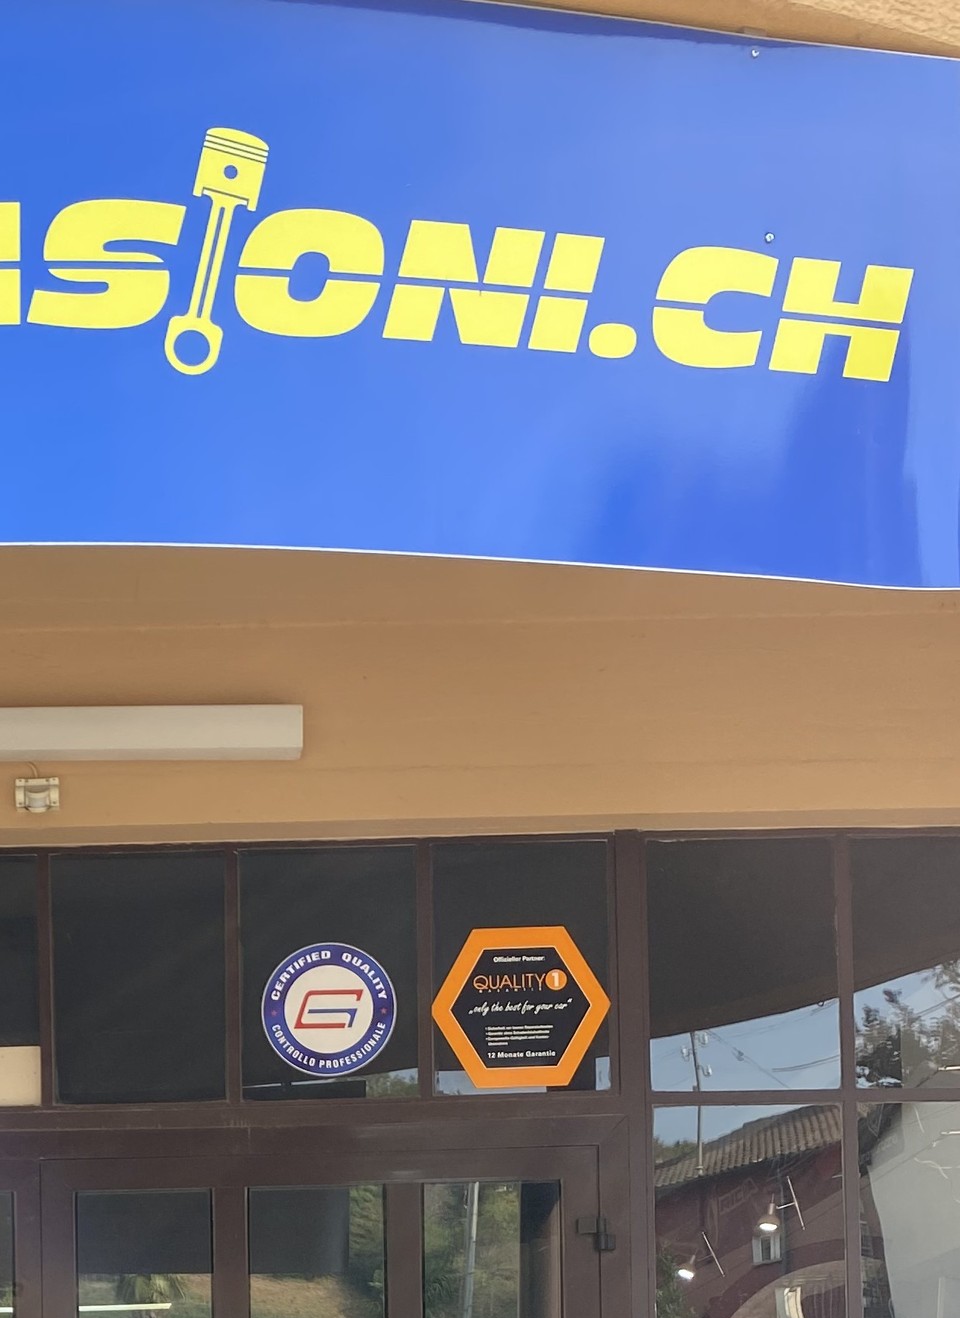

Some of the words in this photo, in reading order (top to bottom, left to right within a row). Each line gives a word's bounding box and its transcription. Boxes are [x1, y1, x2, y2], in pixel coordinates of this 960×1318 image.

[271, 950, 331, 1001] CERTIFIED
[342, 952, 387, 999] QUALITY
[473, 973, 546, 990] QUALITY
[272, 1024, 315, 1067] CONTROLLO
[319, 1022, 386, 1068] PROFESSIONALE
